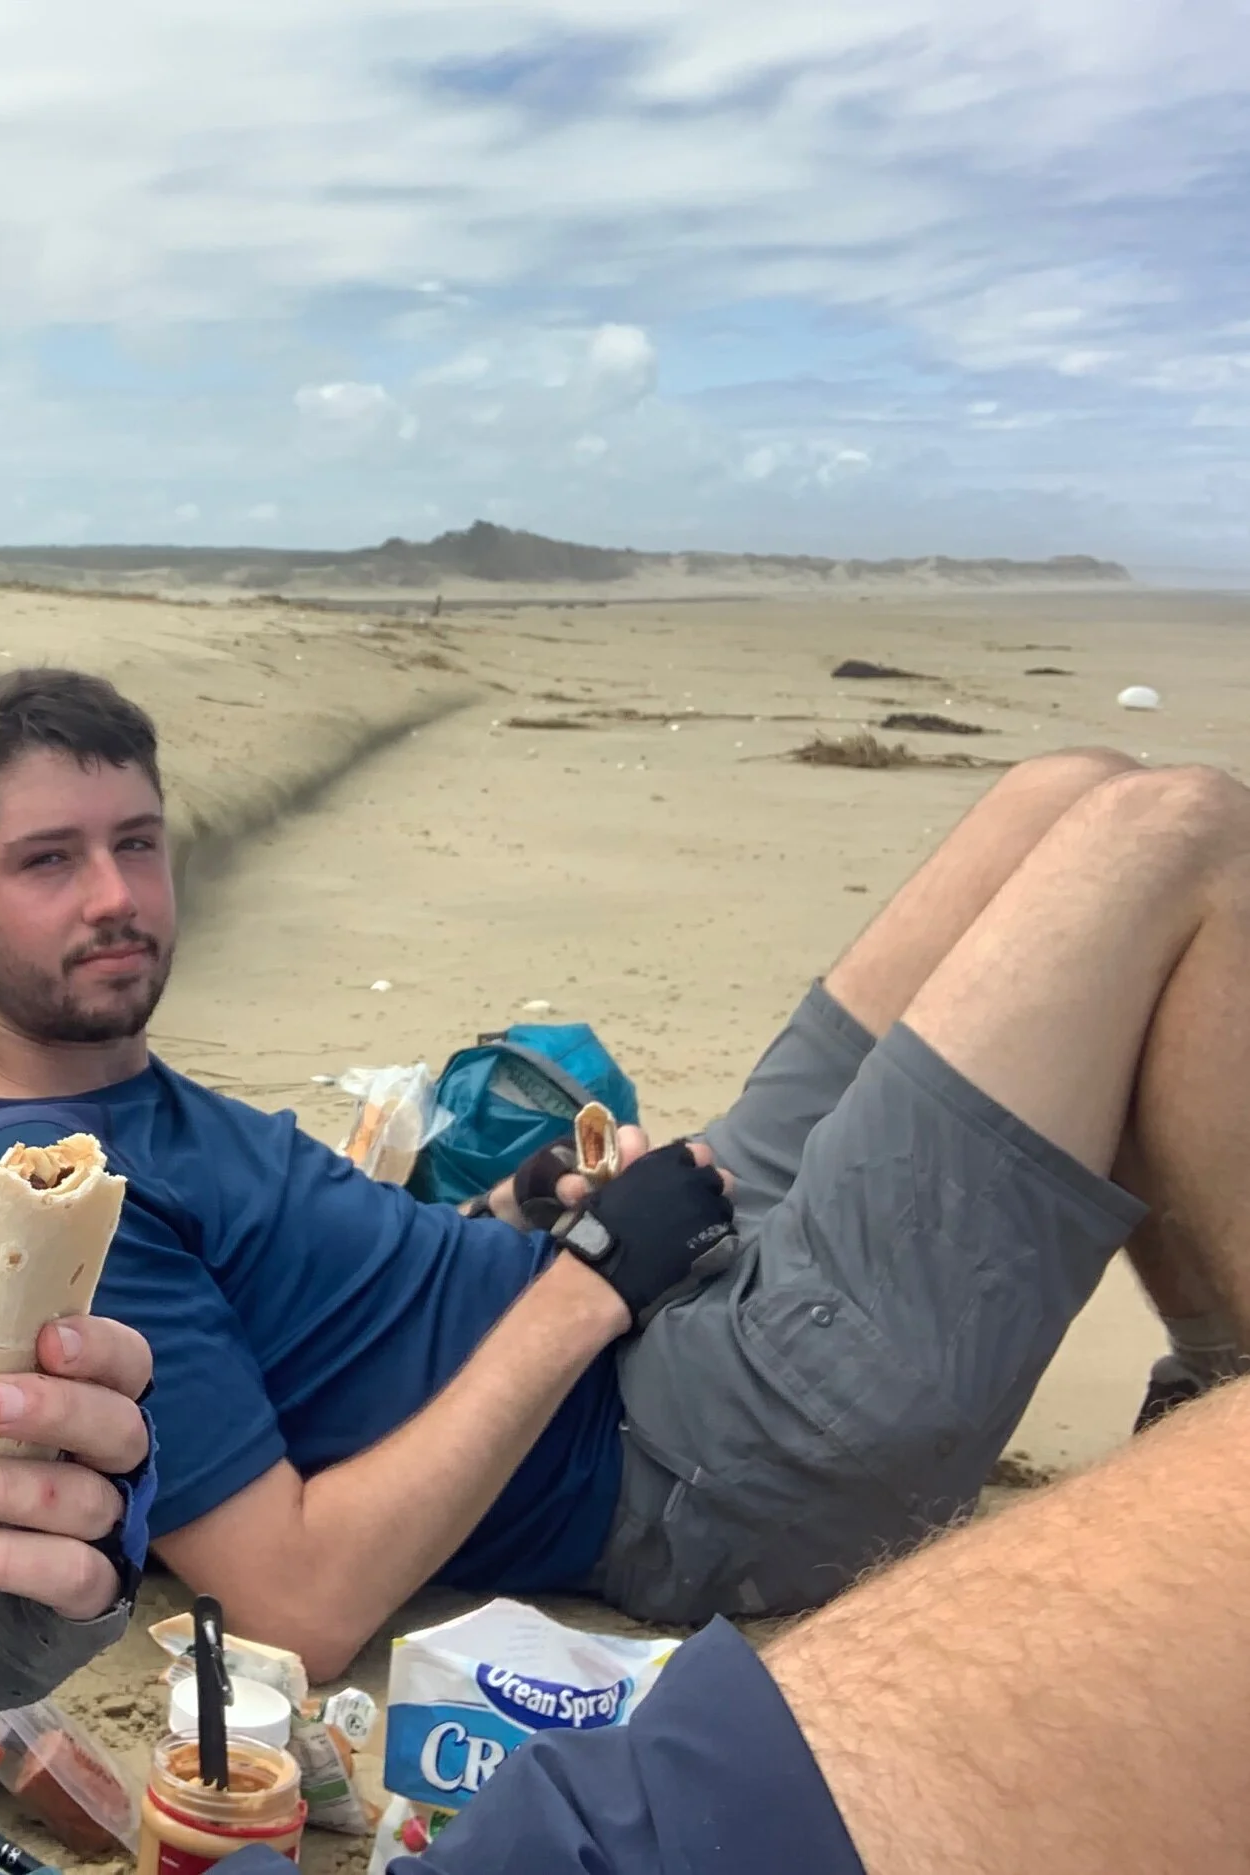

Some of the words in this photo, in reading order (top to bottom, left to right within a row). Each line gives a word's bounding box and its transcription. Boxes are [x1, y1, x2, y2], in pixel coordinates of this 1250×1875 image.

[487, 1666, 557, 1717] Ocean
[558, 1685, 620, 1728] Spray
[420, 1721, 519, 1792] CR
